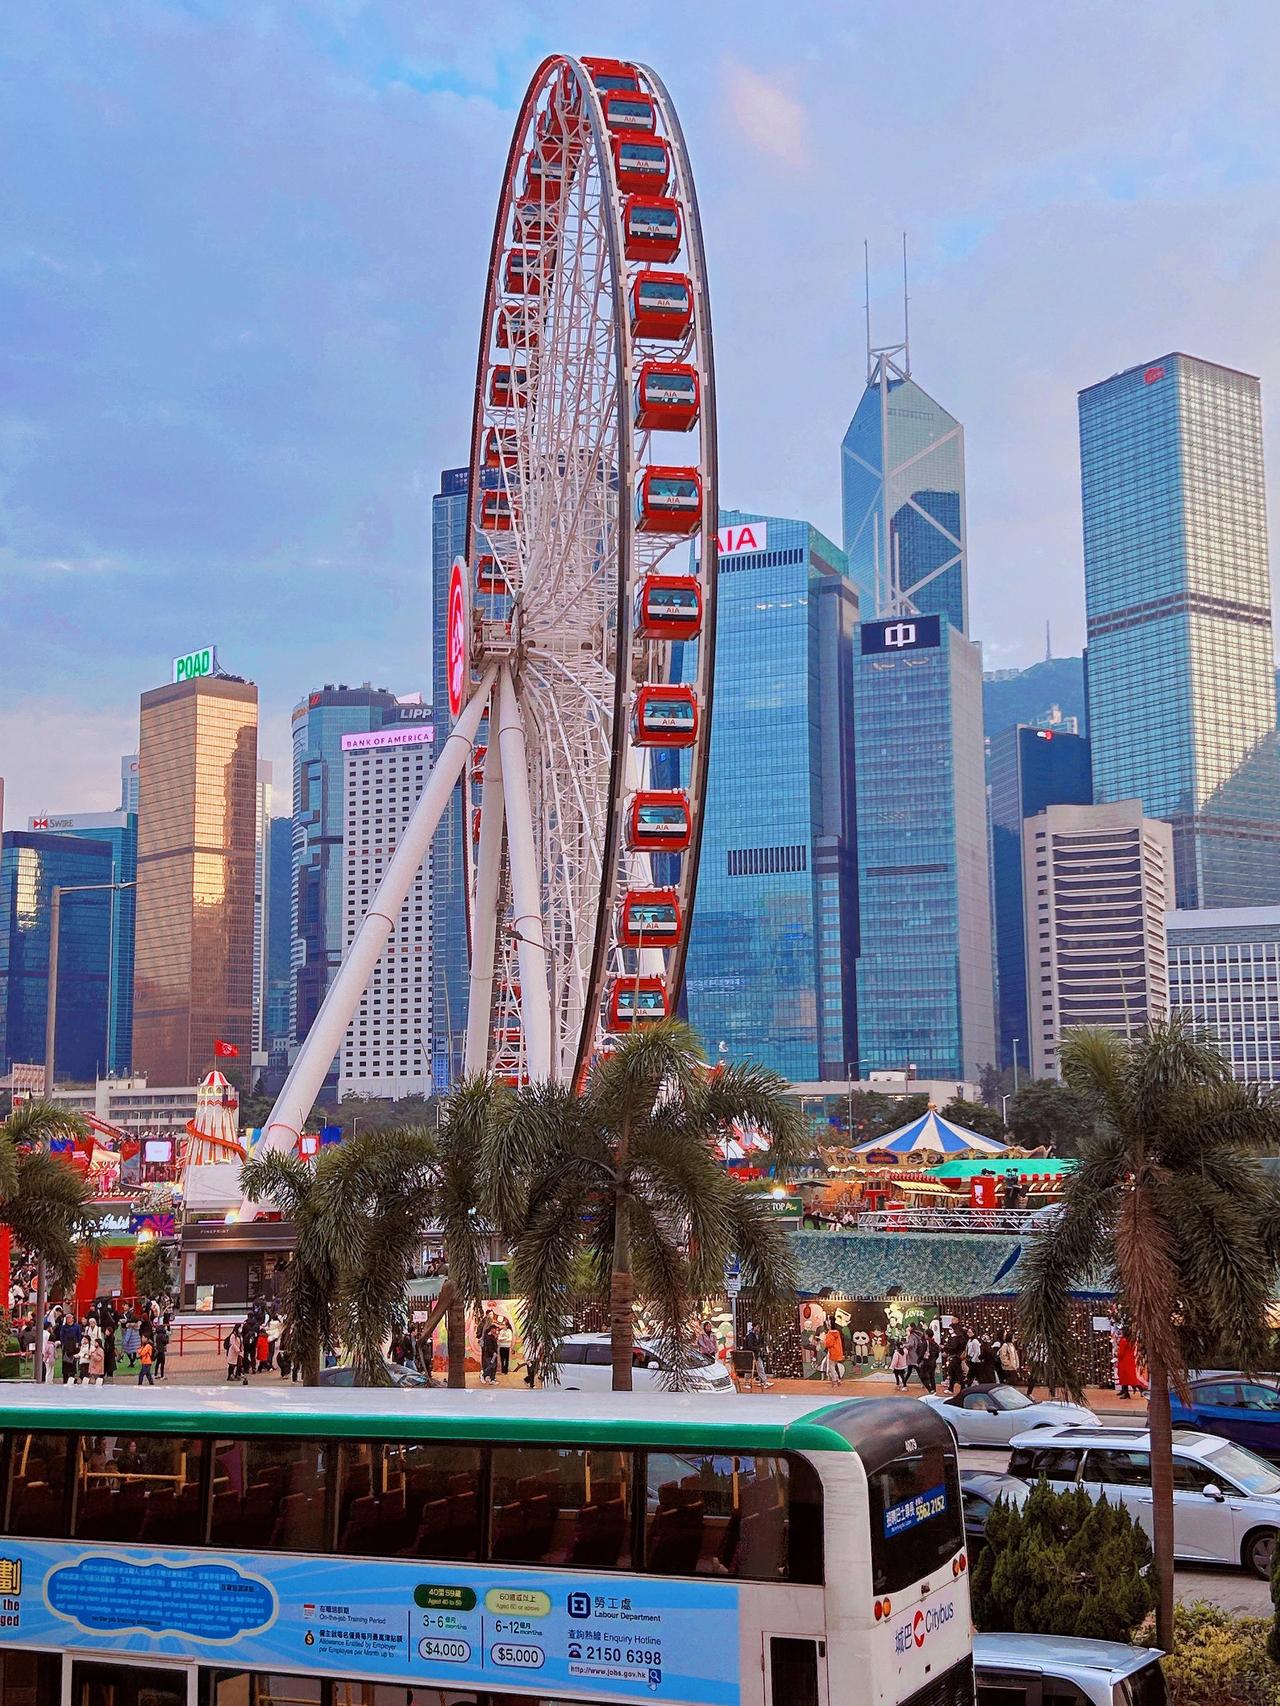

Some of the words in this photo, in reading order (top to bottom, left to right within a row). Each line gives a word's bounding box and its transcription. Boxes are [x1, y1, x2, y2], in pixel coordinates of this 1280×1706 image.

[177, 650, 210, 684] POAD
[400, 708, 433, 719] LIPP
[346, 739, 371, 748] BANK
[387, 733, 429, 744] AMERICA
[3, 1599, 20, 1611] the
[594, 1595, 632, 1611] 勞工處
[369, 1616, 386, 1625] Period
[594, 1610, 618, 1619] Labour
[620, 1612, 661, 1623] Department
[926, 1602, 954, 1633] Citybus
[495, 1620, 519, 1634] 6-12
[603, 1630, 632, 1645] Enquiry
[634, 1633, 662, 1646] Hotline
[425, 1641, 465, 1657] $4,000
[498, 1647, 539, 1663] $5,000
[586, 1646, 621, 1662] 2150
[626, 1649, 662, 1665] 6398
[570, 1665, 646, 1679] http://www.jobs.gov.hk
